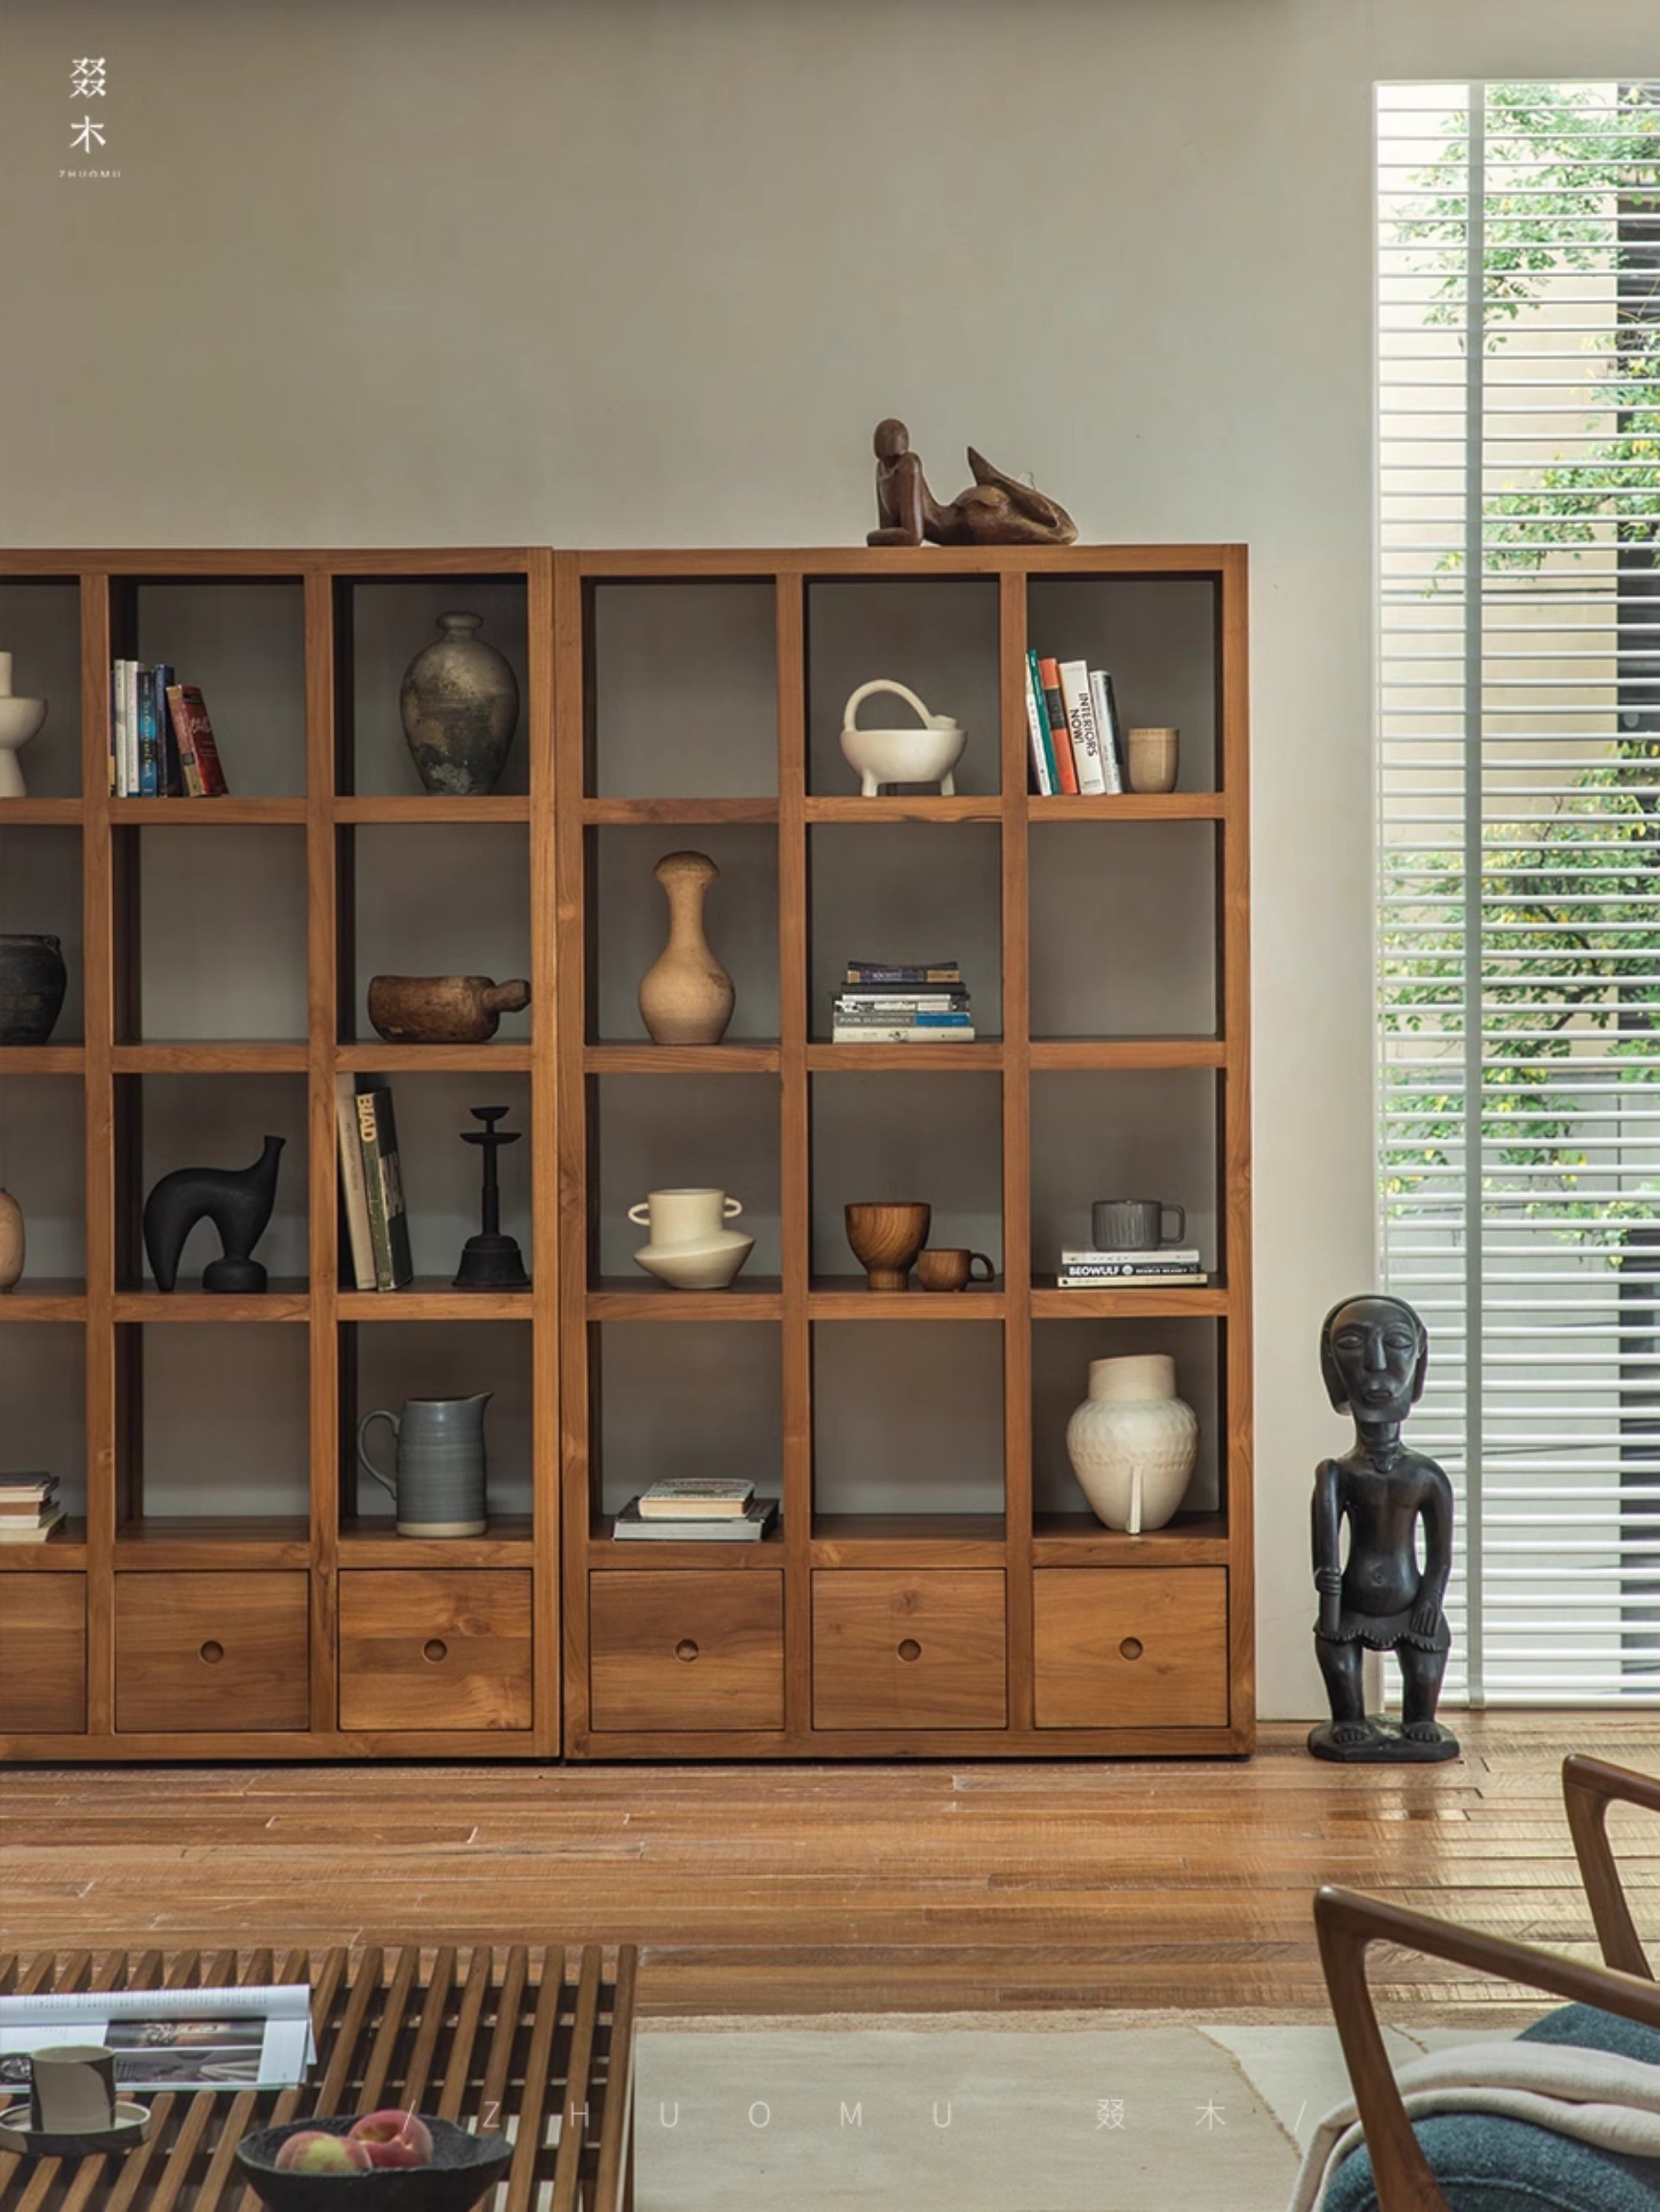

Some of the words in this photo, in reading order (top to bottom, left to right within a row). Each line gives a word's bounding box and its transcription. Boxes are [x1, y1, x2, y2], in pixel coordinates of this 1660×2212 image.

[1070, 709, 1084, 744] NOW!
[1078, 692, 1098, 757] INTERIORS
[358, 1093, 377, 1141] BIAD
[1069, 1265, 1120, 1276] BEOWULF
